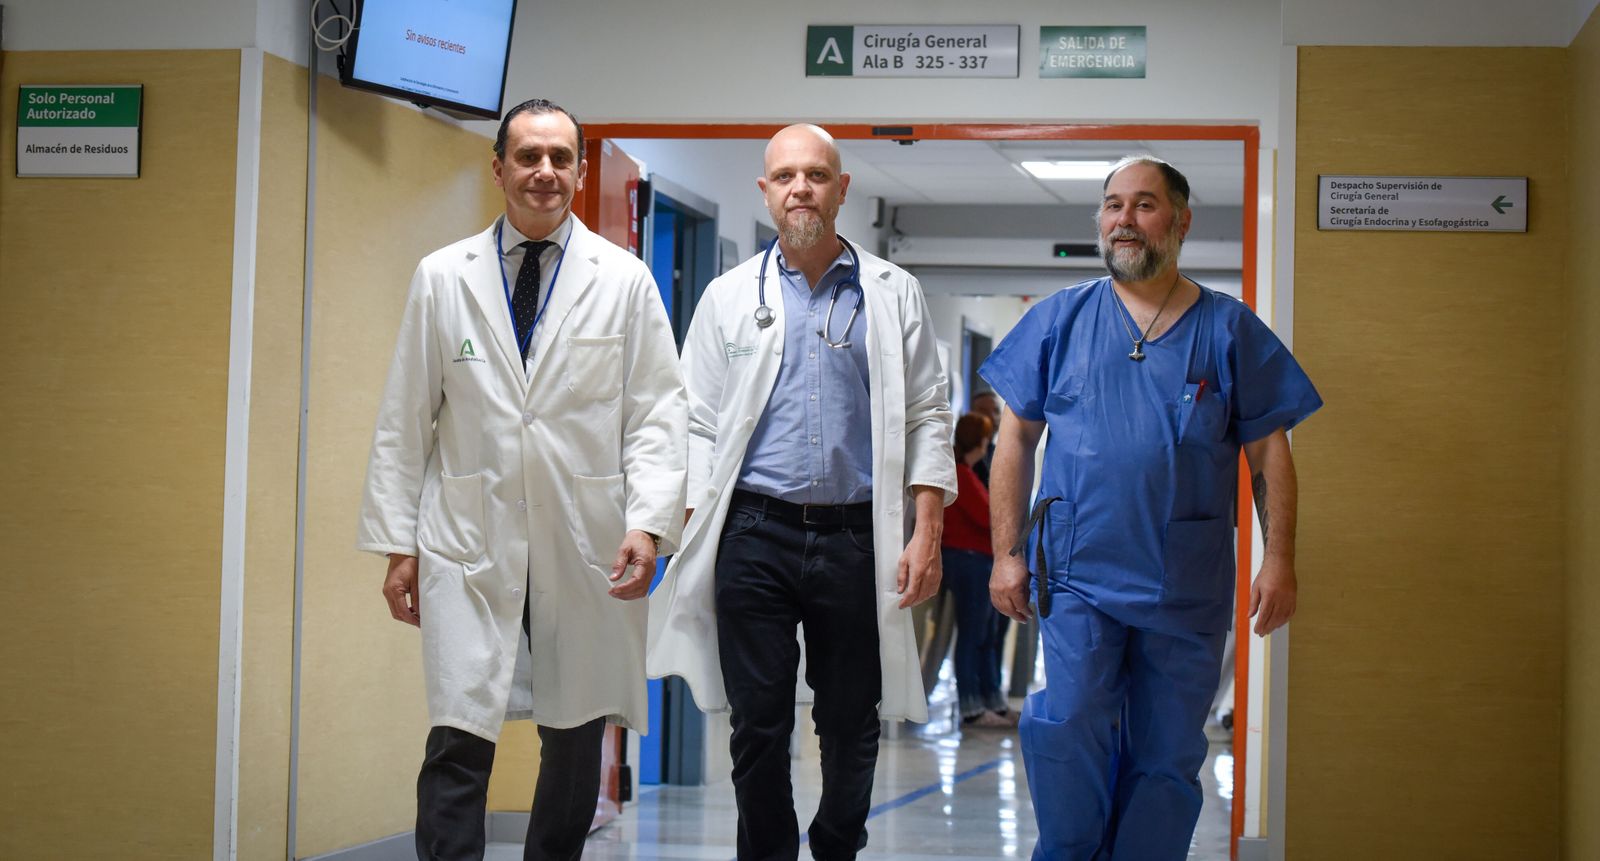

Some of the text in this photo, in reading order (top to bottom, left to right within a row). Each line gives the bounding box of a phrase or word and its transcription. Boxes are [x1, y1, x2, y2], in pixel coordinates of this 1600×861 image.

[405, 29, 467, 55] Sin avisos recientes
[863, 32, 988, 52] Cirugía General
[1059, 36, 1126, 50] SALIDA DE
[862, 54, 891, 69] Ala
[893, 55, 904, 69] B
[915, 55, 945, 69] 325
[959, 55, 988, 69] 337
[1049, 55, 1135, 68] EMERGENCIA
[28, 92, 115, 104] Solo Personal
[26, 107, 96, 120] Autorizado
[25, 143, 129, 154] Almacén de Residuos
[1330, 181, 1442, 191] Despacho Supervisión de
[1330, 191, 1399, 202] Cirugía General
[1330, 205, 1389, 215] Secretaría de
[1330, 216, 1489, 228] Cirugía Endocrina y Esofagogástrica
